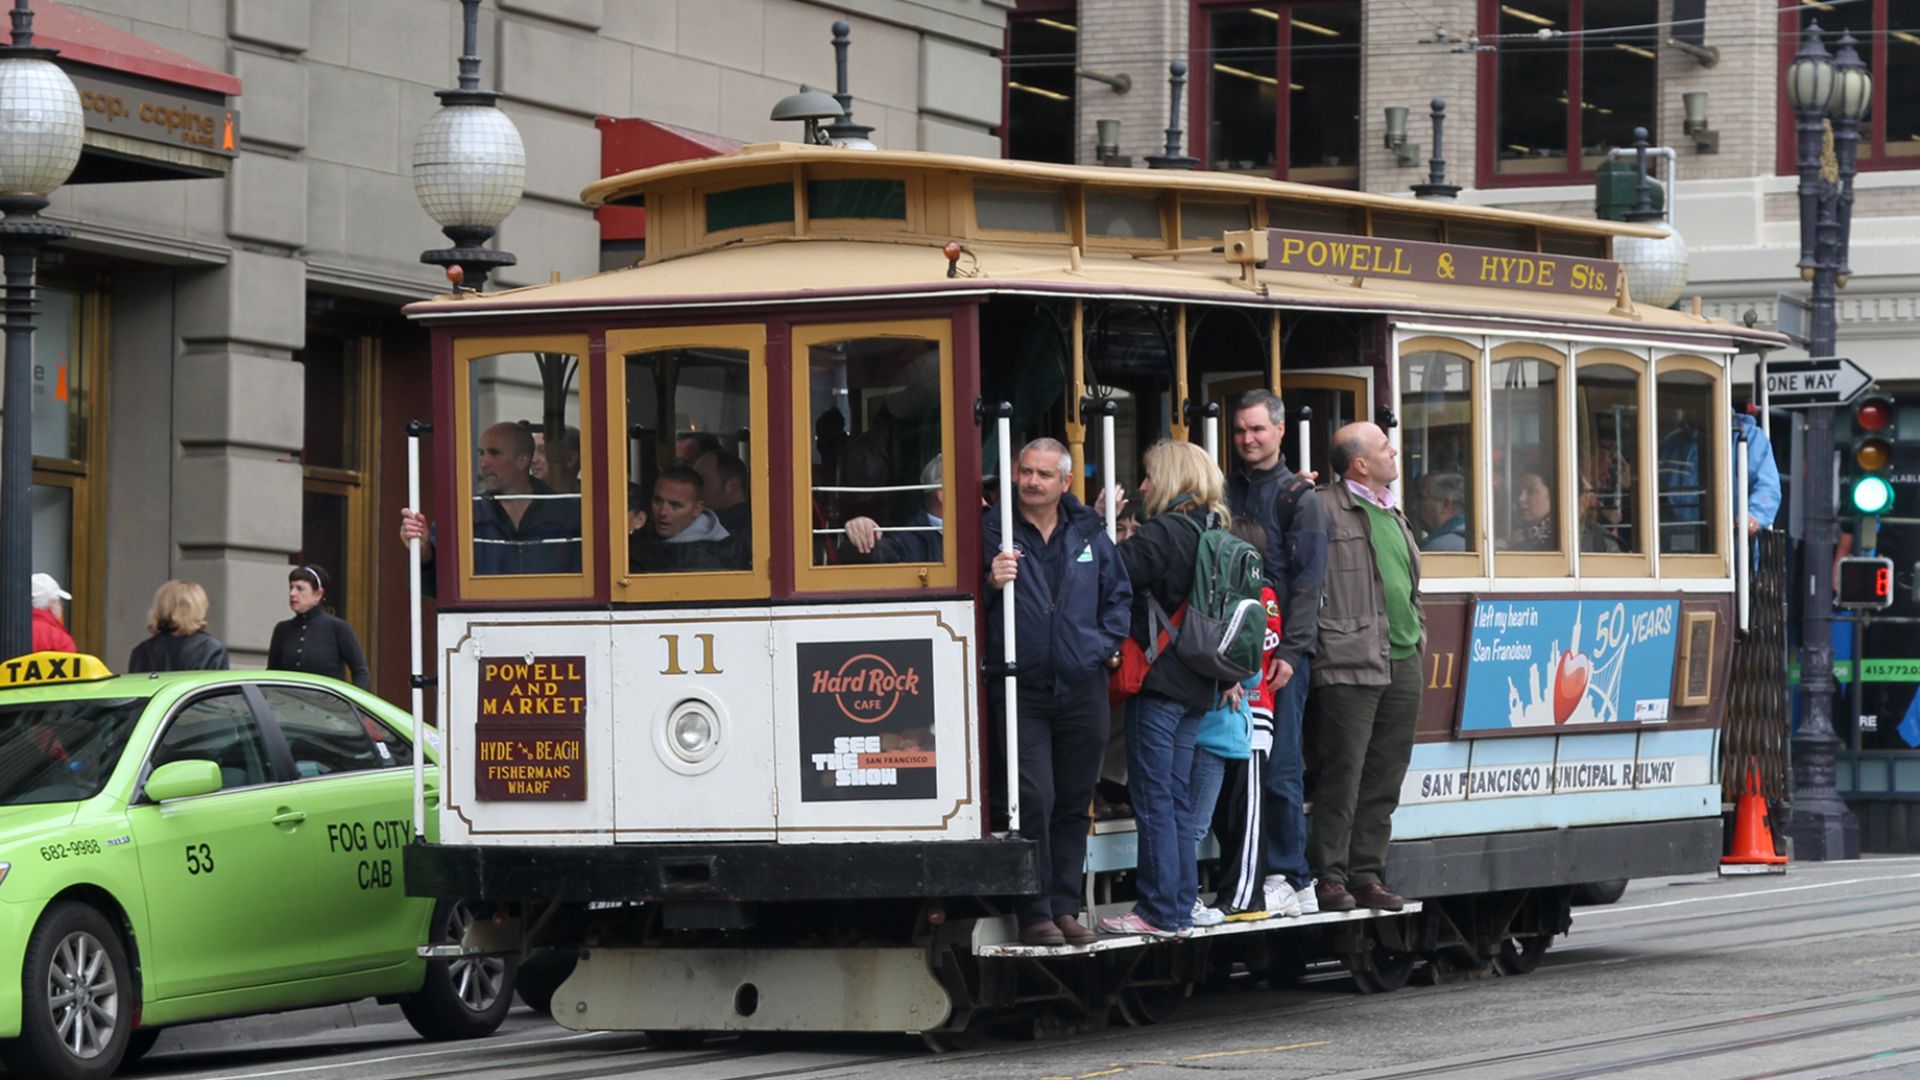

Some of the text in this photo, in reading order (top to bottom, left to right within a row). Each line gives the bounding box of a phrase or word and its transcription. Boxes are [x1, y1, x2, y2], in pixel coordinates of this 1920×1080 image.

[80, 90, 215, 135] cop. copine
[1281, 238, 1608, 292] POWELL & HYDE Sts.
[1767, 373, 1835, 392] ONE WAY
[1479, 604, 1494, 628] left
[1495, 611, 1508, 634] my
[1508, 604, 1530, 627] heart
[1530, 606, 1539, 626] in
[1594, 602, 1672, 658] 50 YEARS
[659, 634, 724, 675] 11
[1473, 638, 1532, 661] San Francisco
[6, 657, 81, 683] TAXI
[486, 664, 581, 681] POWELL
[1428, 652, 1453, 689] 11
[1865, 665, 1920, 675] 415.772.0
[511, 683, 557, 695] AND
[812, 668, 919, 696] Hard Rock
[483, 698, 583, 715] MARKET
[854, 699, 881, 710] CAFE
[481, 741, 514, 761] HYDE
[536, 740, 579, 761] BEACH
[834, 736, 880, 753] SEE
[812, 753, 859, 771] THE
[865, 755, 928, 765] SAN FRANCISCO
[488, 765, 571, 779] FISHERMANS
[835, 768, 897, 786] SHOW
[1421, 761, 1675, 798] SAN FRANCISCO MUNICIPAL RAILWAY
[508, 781, 551, 794] WHARF
[327, 820, 410, 853] FOG CITY
[40, 839, 101, 861] 682-9988
[186, 843, 214, 875] 53
[357, 859, 392, 890] CAB
